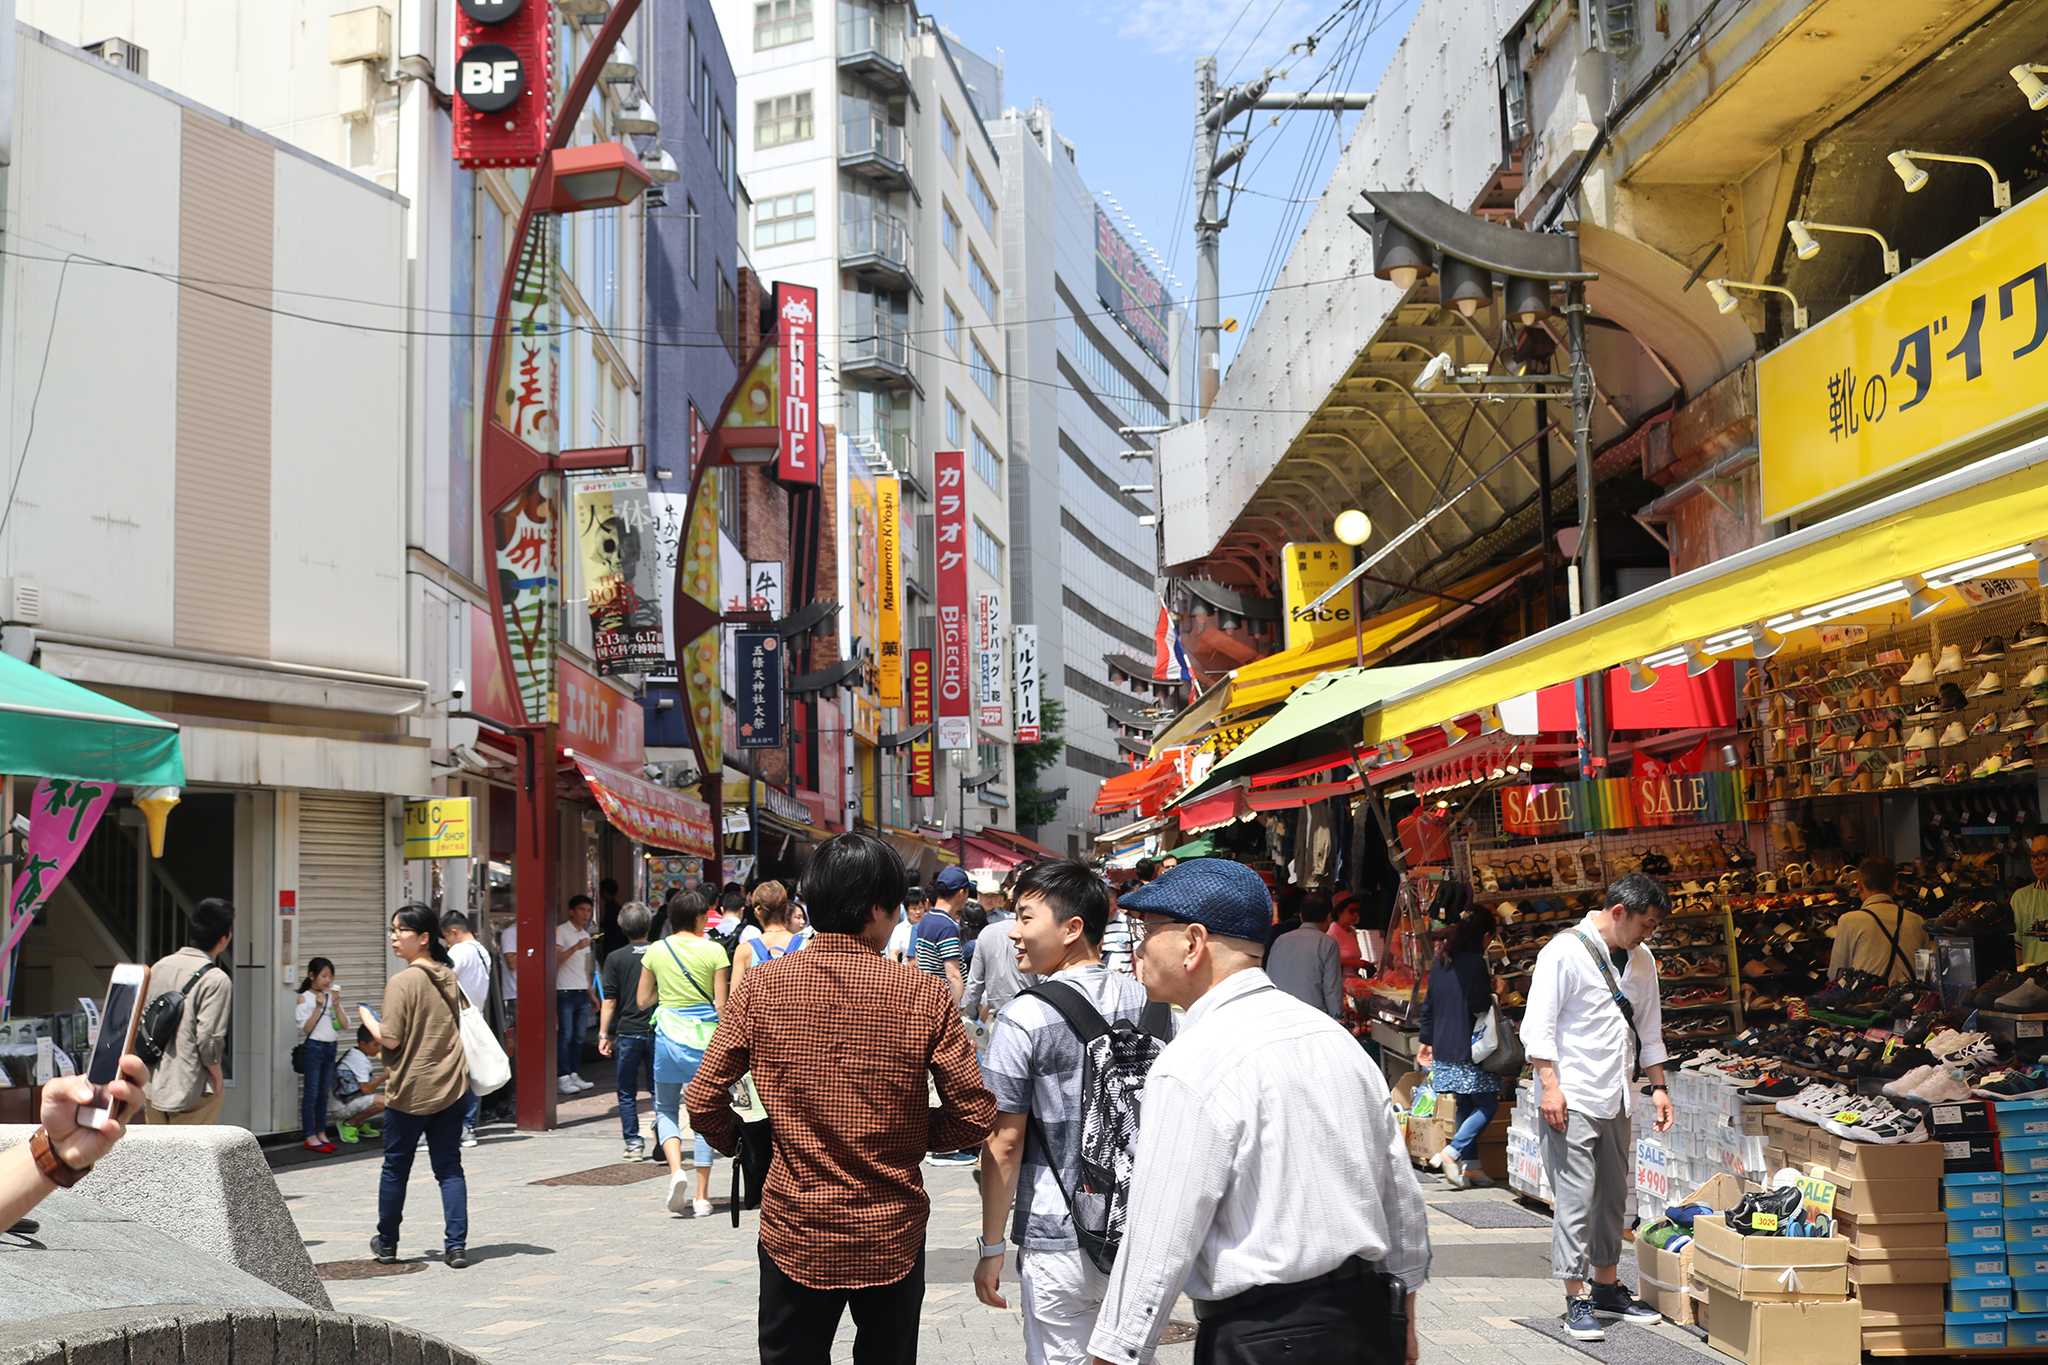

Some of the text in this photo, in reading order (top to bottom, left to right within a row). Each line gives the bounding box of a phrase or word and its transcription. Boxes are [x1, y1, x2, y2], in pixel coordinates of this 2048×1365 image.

[461, 61, 518, 94] BF
[1827, 263, 2048, 443] 靴のダイワ
[786, 325, 809, 468] GAME
[939, 467, 962, 571] カラオケ
[883, 540, 894, 611] Matsumoto
[940, 606, 960, 642] BIG
[1290, 606, 1350, 622] face
[635, 631, 657, 643] 6.17
[942, 646, 961, 700] ECHO
[1019, 649, 1037, 725] ルノアール
[913, 661, 929, 727] OUTLE
[1508, 787, 1574, 825] SALE
[1642, 777, 1708, 815] SALE
[1638, 1144, 1665, 1166] SALE
[1638, 1167, 1665, 1195] ¥990
[1797, 1179, 1834, 1203] SALE
